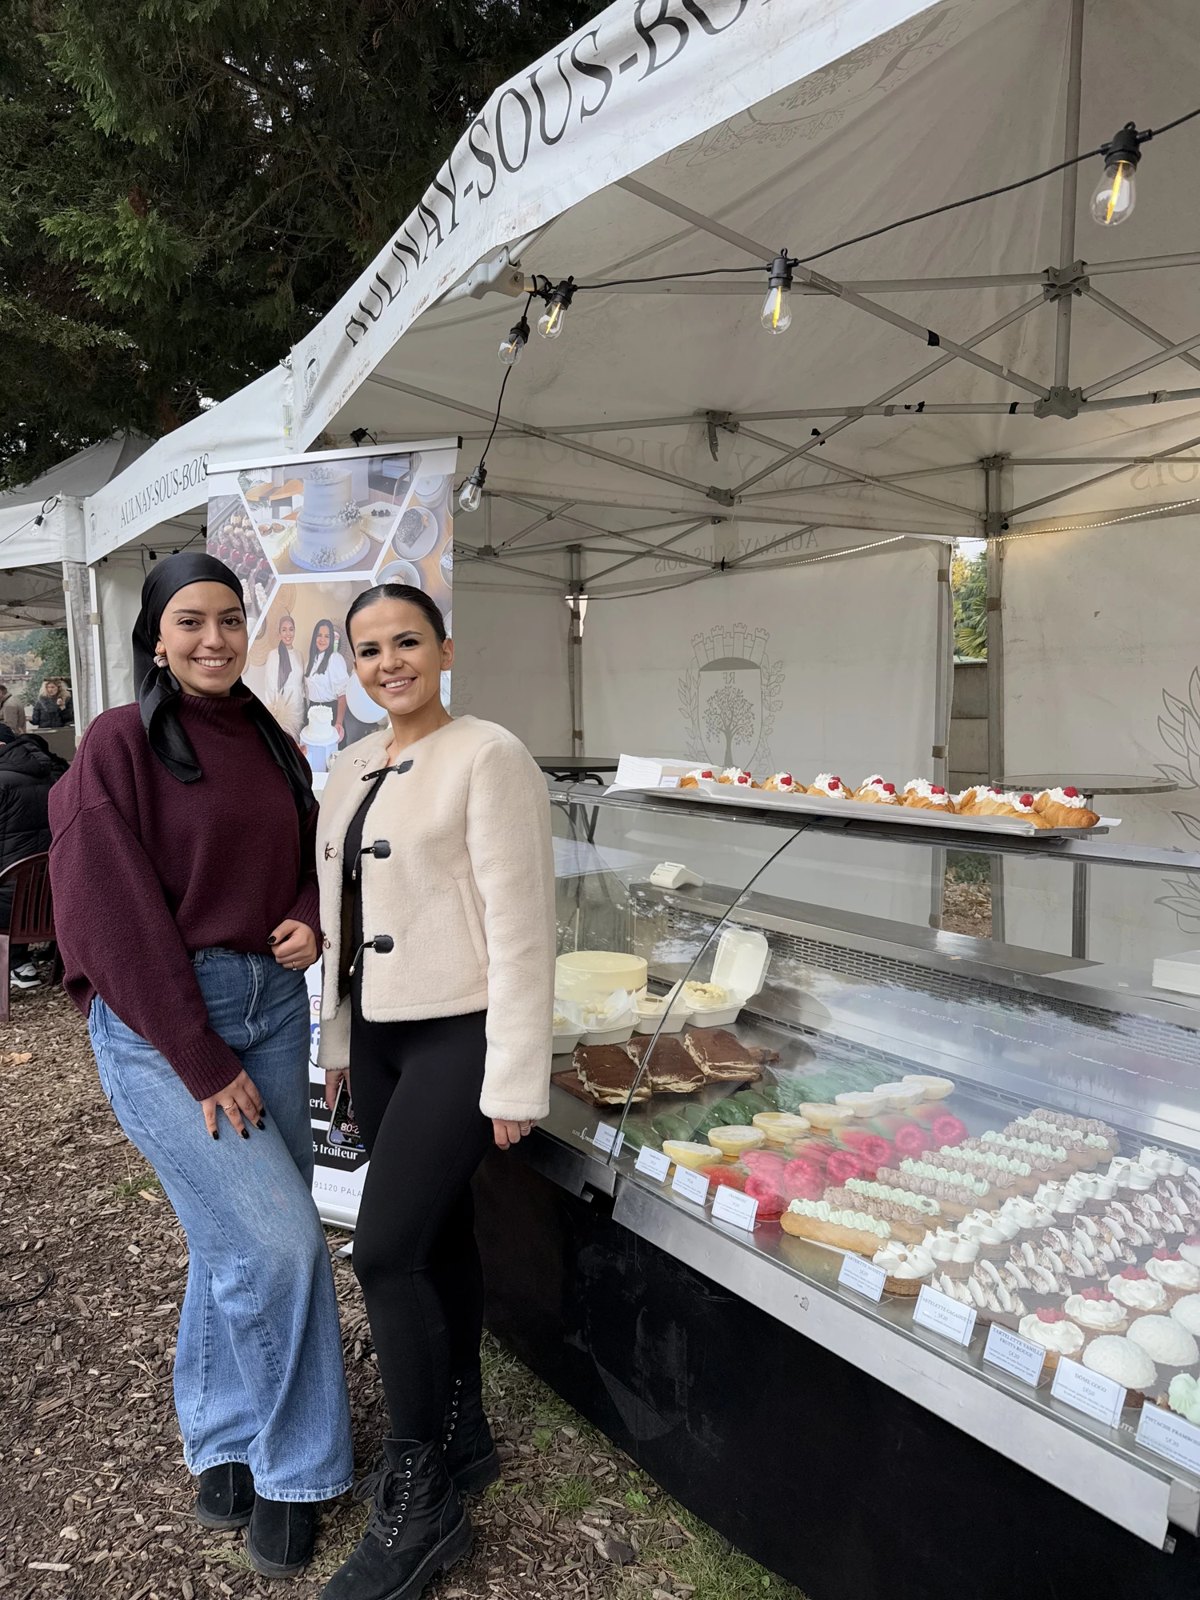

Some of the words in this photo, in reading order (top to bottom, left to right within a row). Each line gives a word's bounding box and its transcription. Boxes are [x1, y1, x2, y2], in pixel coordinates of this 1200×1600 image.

[343, 0, 769, 347] AULNAY-SOUS-BO
[120, 452, 208, 529] AULNAY-SOUS-BOIS
[320, 1143, 358, 1160] traiteur
[313, 1180, 338, 1193] 91120
